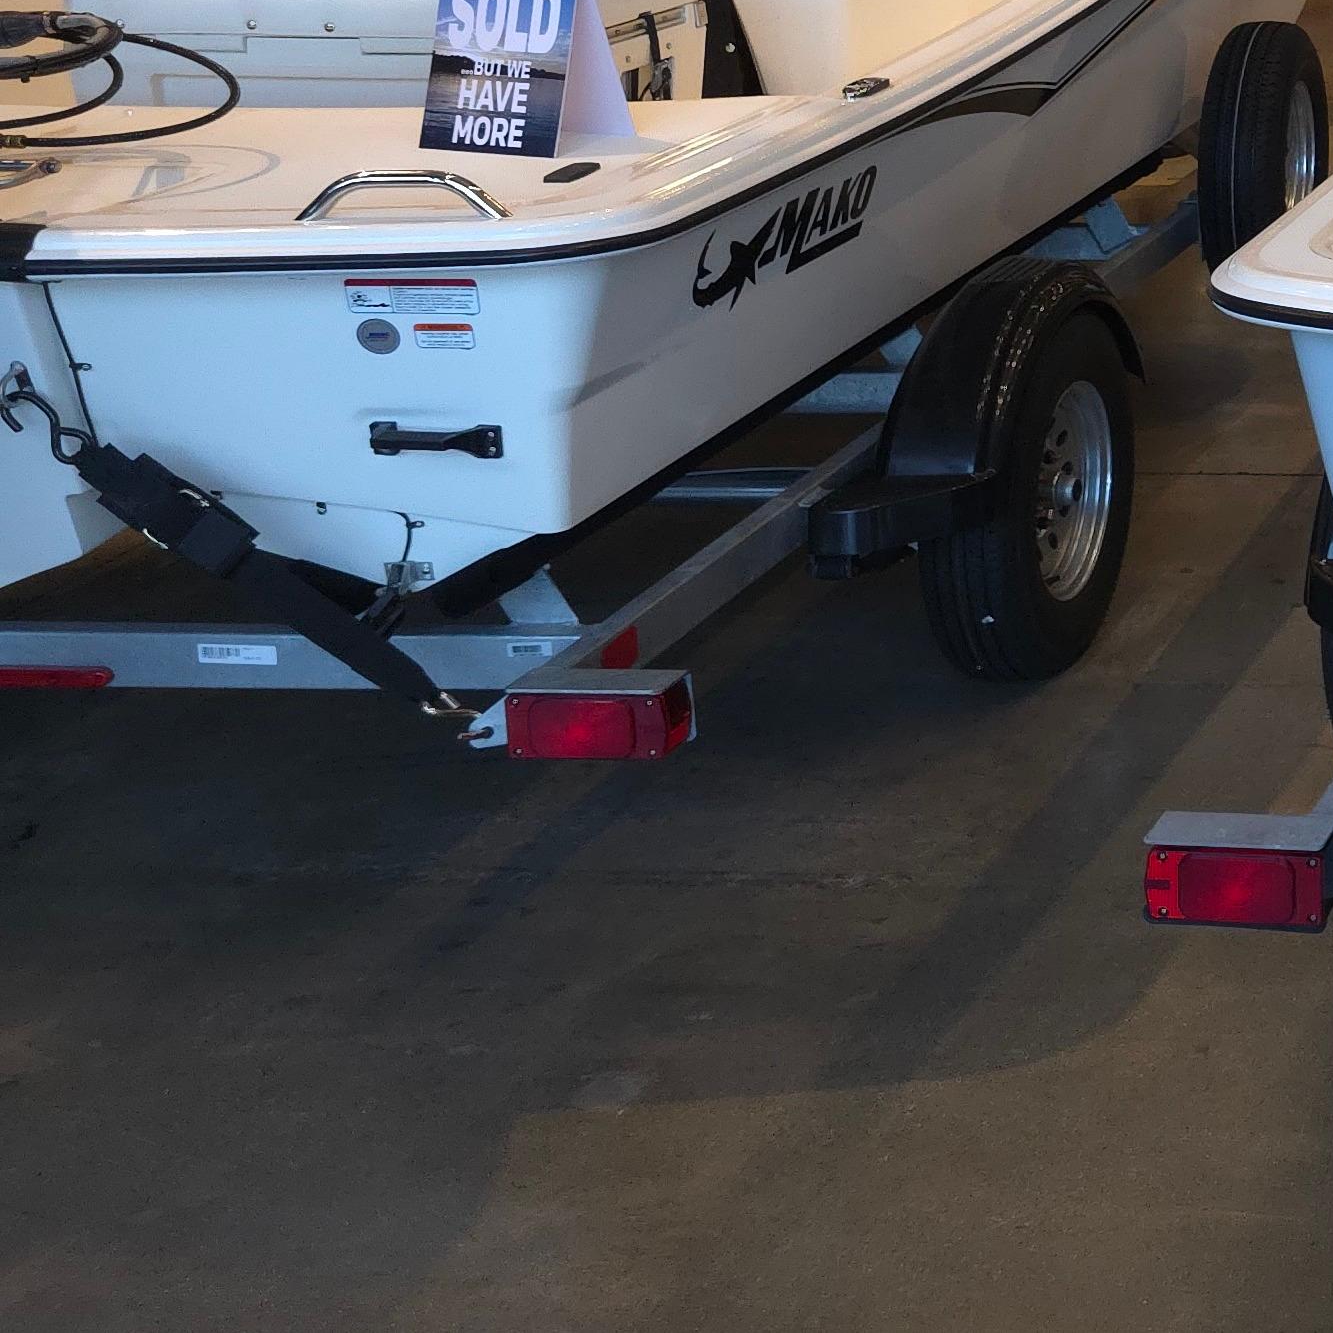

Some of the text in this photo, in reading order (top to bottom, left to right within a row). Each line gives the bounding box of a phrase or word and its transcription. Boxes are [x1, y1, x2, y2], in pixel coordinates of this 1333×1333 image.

[506, 60, 533, 79] WE
[457, 78, 531, 114] HAVE
[451, 114, 526, 149] MORE
[758, 165, 878, 274] MAKO
